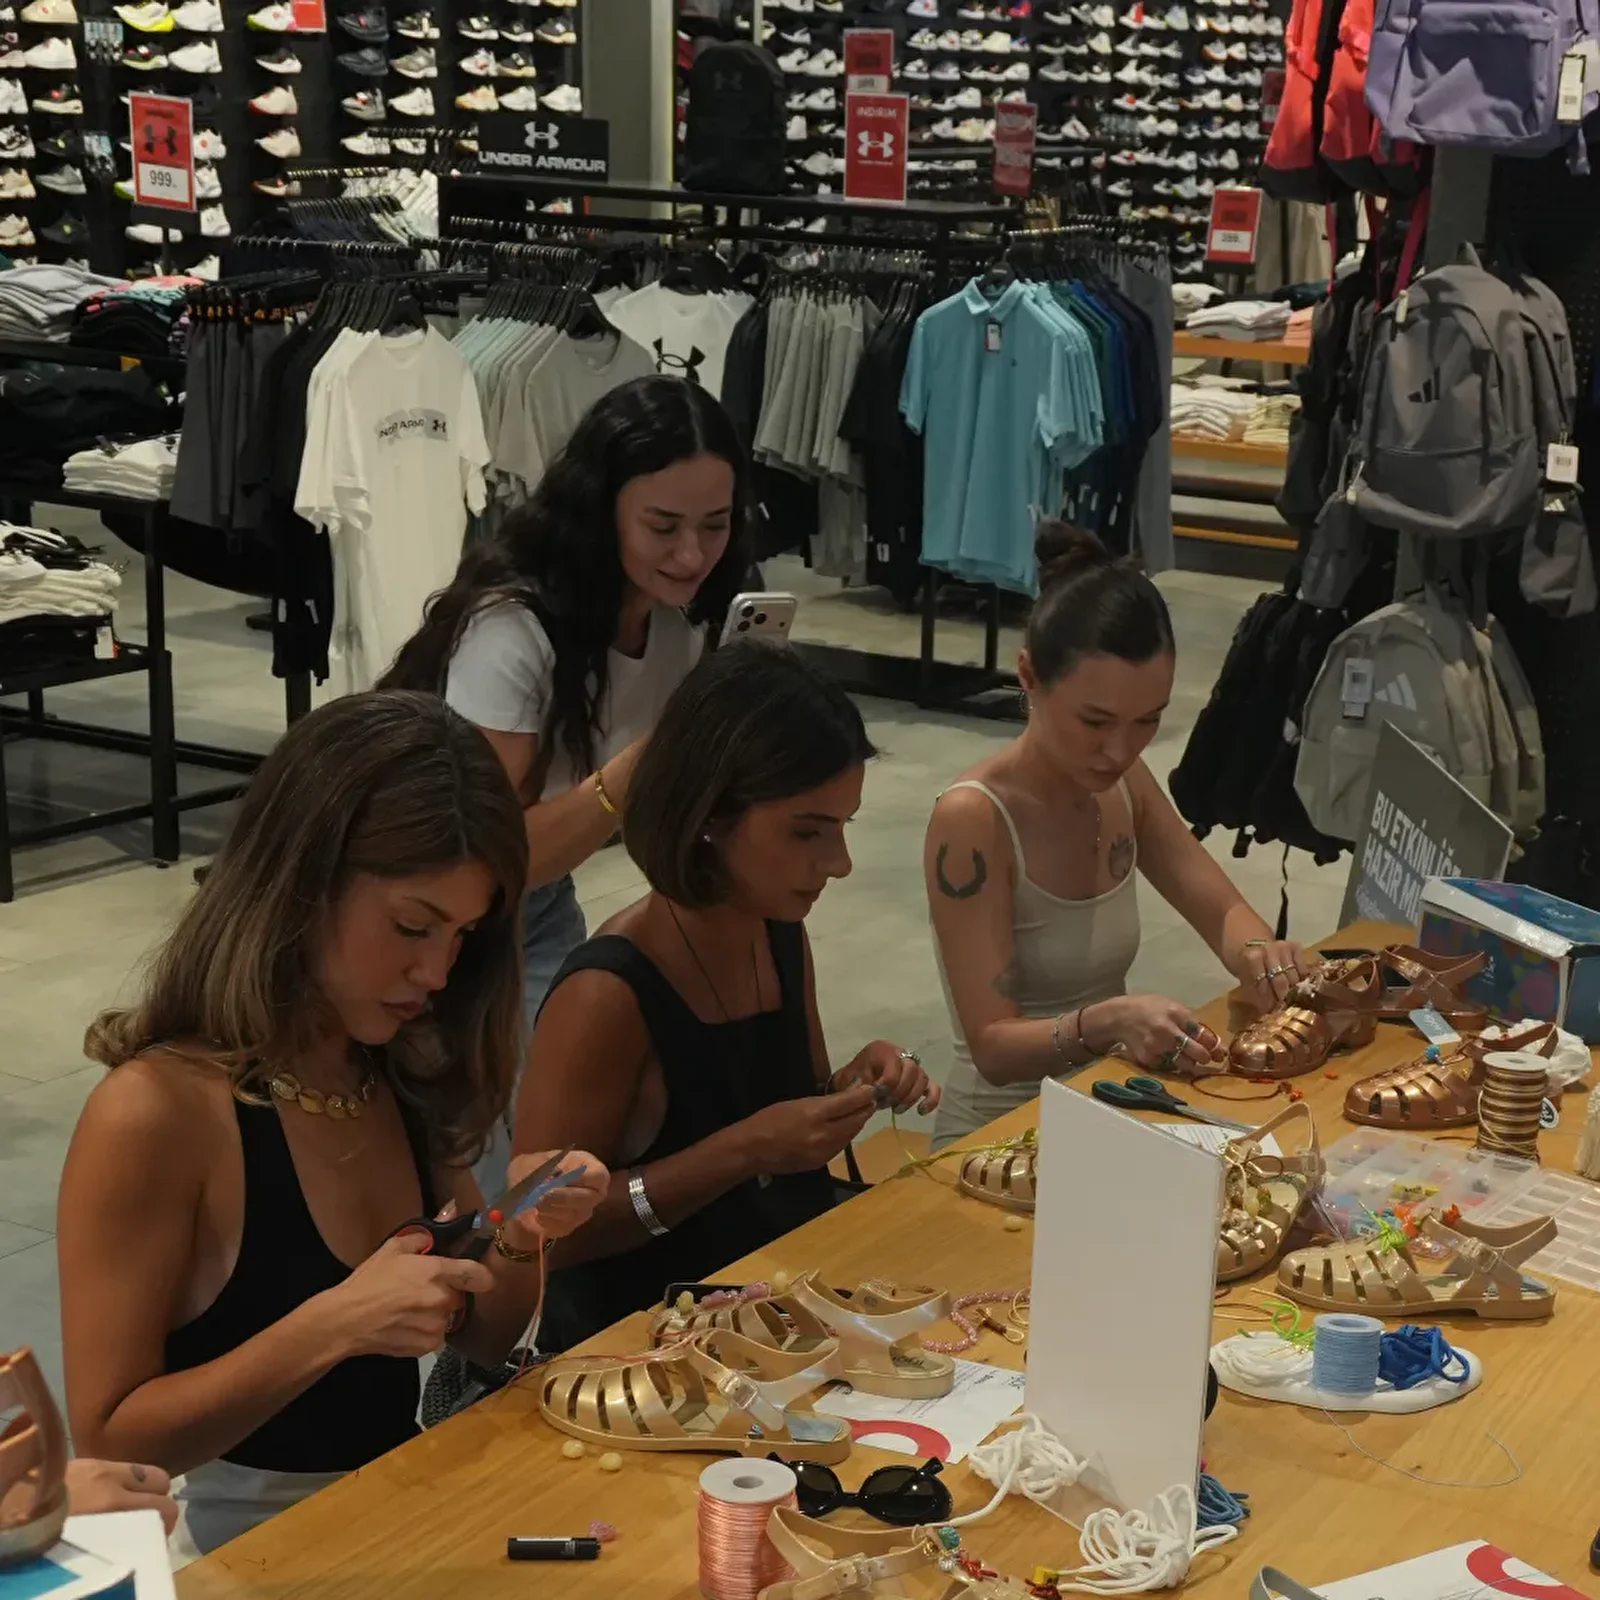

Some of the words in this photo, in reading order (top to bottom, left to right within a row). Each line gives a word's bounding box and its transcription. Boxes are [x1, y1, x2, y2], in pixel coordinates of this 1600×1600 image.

[478, 150, 533, 167] UNDER
[535, 154, 606, 173] ARMOUR
[1362, 832, 1404, 905] HAZIR
[1371, 789, 1395, 838] BU
[1389, 808, 1462, 878] ETKİNLİĞ
